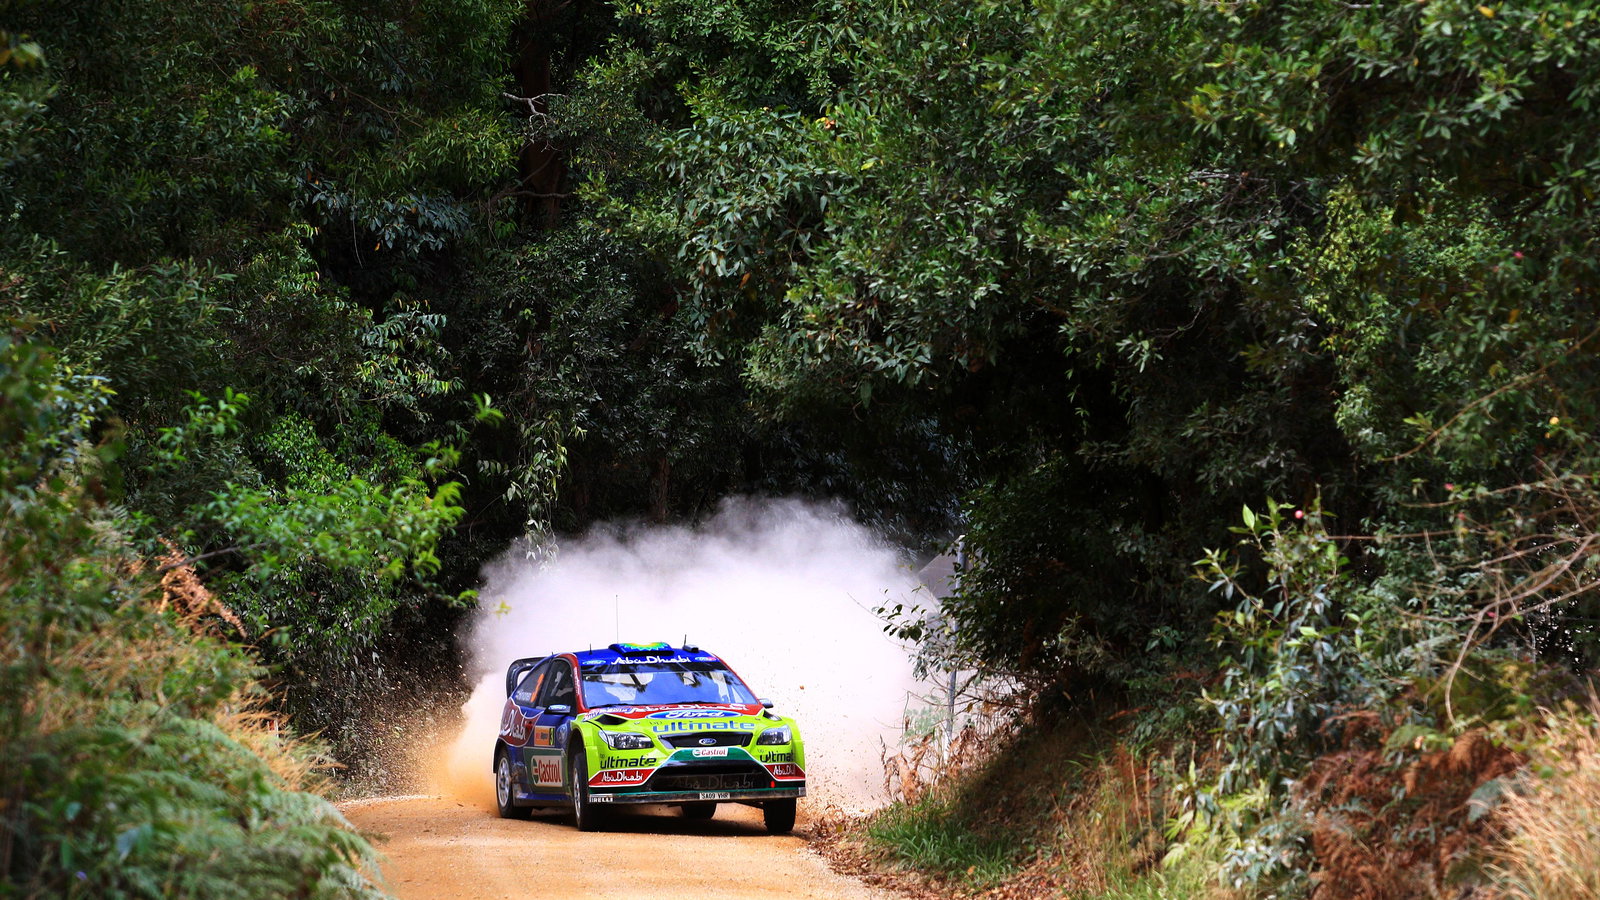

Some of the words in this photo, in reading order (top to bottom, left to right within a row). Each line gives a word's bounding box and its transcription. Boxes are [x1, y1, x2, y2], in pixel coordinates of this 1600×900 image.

[665, 710, 726, 719] Ford
[652, 720, 755, 733] ultimate
[600, 755, 657, 769] ultimate
[760, 750, 794, 763] ultima
[538, 759, 562, 783] Castrol
